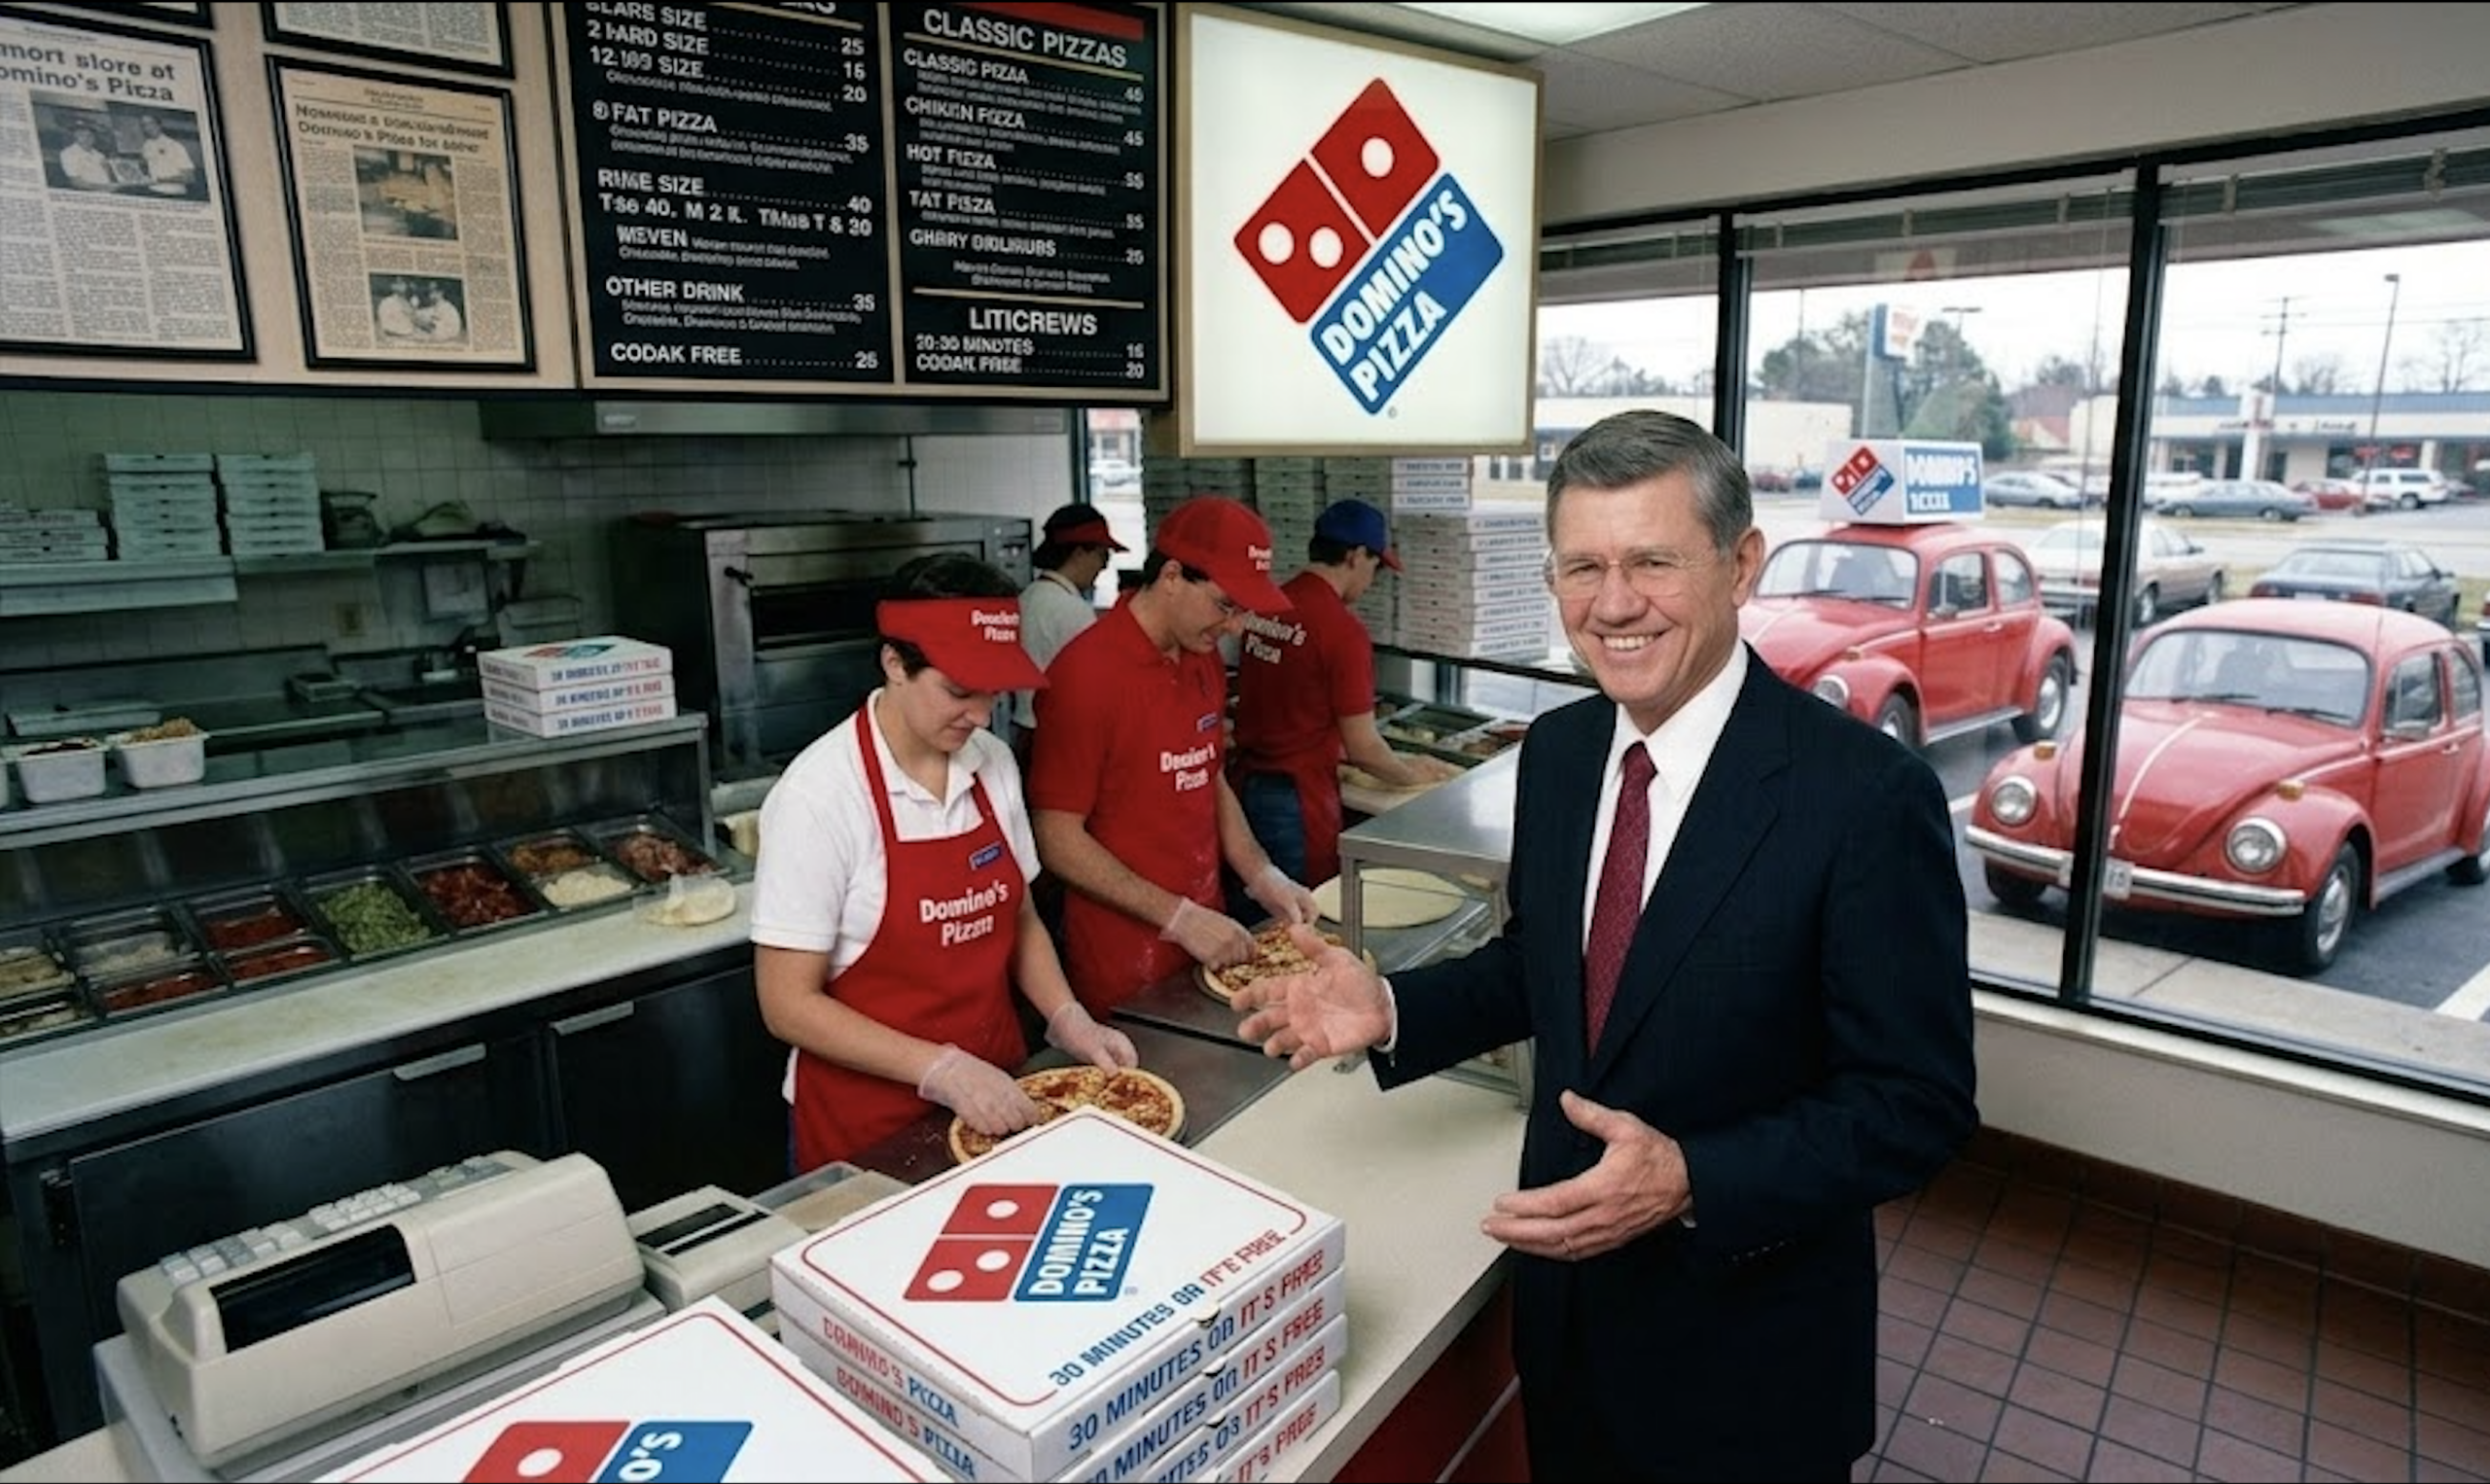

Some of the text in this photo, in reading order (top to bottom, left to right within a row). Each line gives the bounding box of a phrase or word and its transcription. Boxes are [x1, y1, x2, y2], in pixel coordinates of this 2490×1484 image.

[587, 18, 602, 40] 2
[662, 31, 710, 55] SIZE
[660, 6, 707, 32] SIZE
[840, 37, 865, 56] 25
[924, 9, 1127, 68] CLASSIC PIZZAS
[658, 55, 704, 79] SIZE
[842, 86, 867, 103] 20
[903, 49, 978, 77] CLASSIC
[611, 102, 653, 125] FAT
[658, 107, 718, 133] PIZZA
[907, 145, 942, 163] HOT
[658, 175, 705, 197] SIZE
[685, 201, 705, 222] M
[606, 276, 678, 300] OTHER
[683, 281, 744, 302] DRINK
[1320, 190, 1467, 365] DOMINO'S
[611, 343, 686, 364] CODAK
[691, 345, 742, 366] FREE
[1349, 291, 1447, 403] PIZZA
[1028, 1189, 1103, 1295] DOMINO'S
[1073, 1227, 1129, 1295] PIZZA
[1069, 1414, 1098, 1450] 30
[1106, 1339, 1203, 1426] MINUTES
[1115, 1392, 1206, 1481] MINUTES
